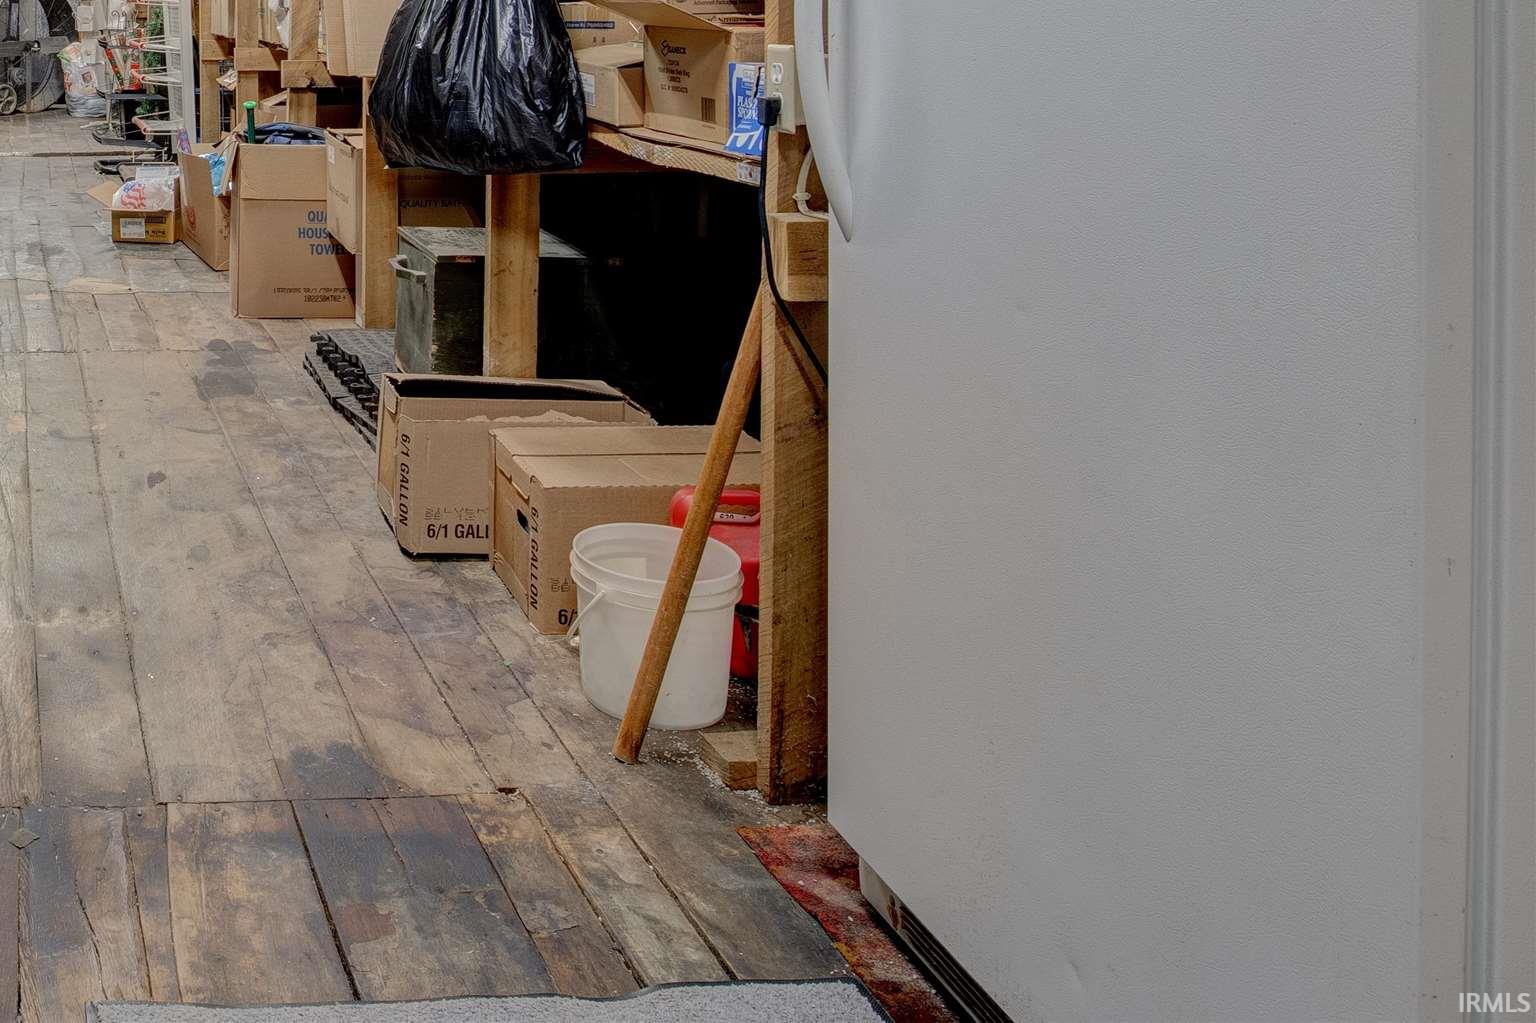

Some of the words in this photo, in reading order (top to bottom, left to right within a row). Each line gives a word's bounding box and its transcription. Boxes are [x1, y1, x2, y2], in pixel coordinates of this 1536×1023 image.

[401, 432, 411, 458] 6/1
[398, 461, 410, 527] GALLON
[427, 523, 449, 540] 6/1
[532, 506, 541, 533] 6/1
[528, 536, 540, 610] GALLON
